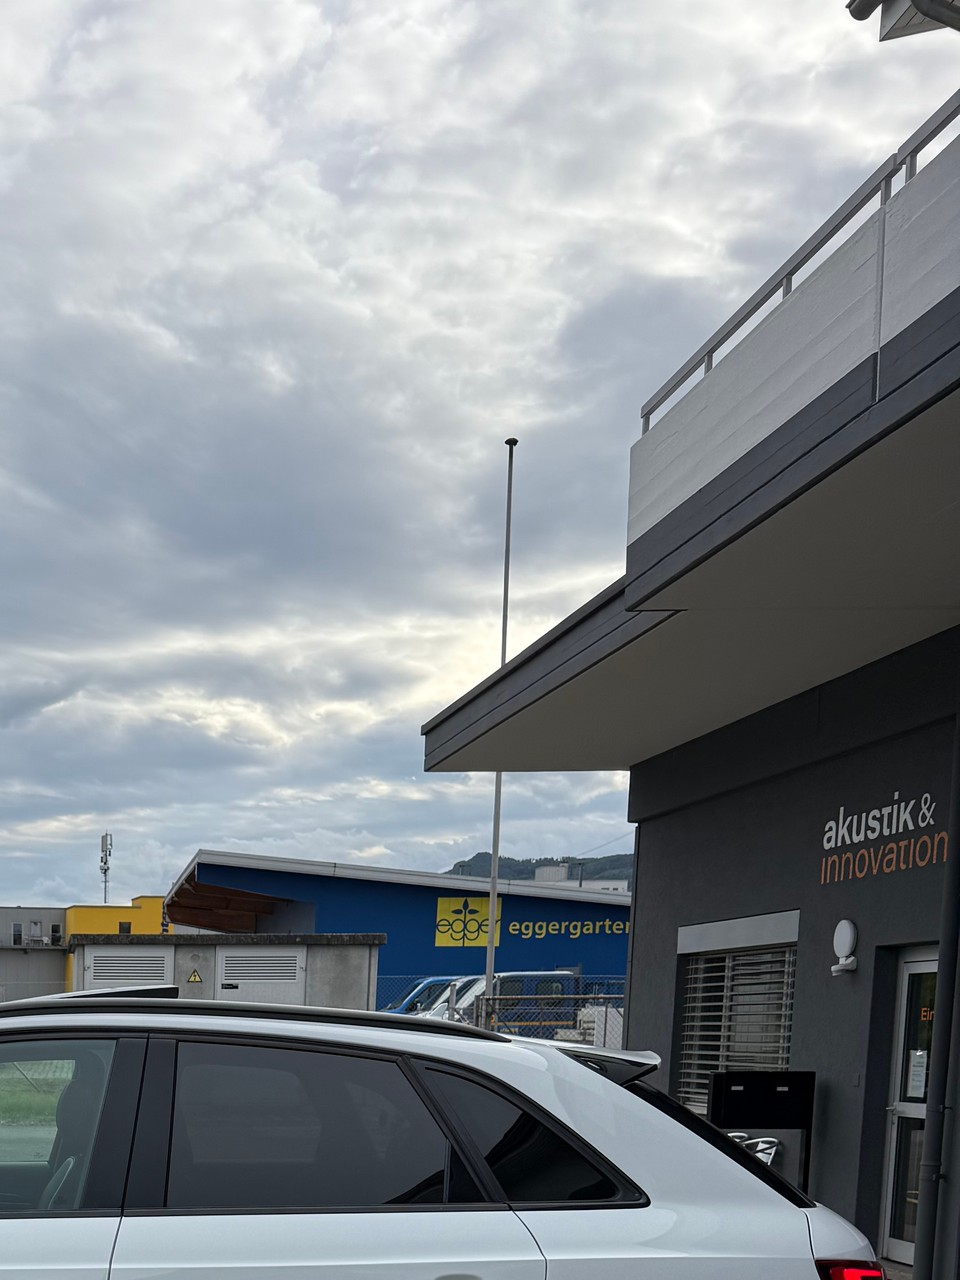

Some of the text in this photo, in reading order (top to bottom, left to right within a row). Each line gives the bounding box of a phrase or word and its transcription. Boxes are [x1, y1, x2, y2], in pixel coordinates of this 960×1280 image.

[822, 791, 937, 850] akustik &
[820, 831, 949, 885] innovation
